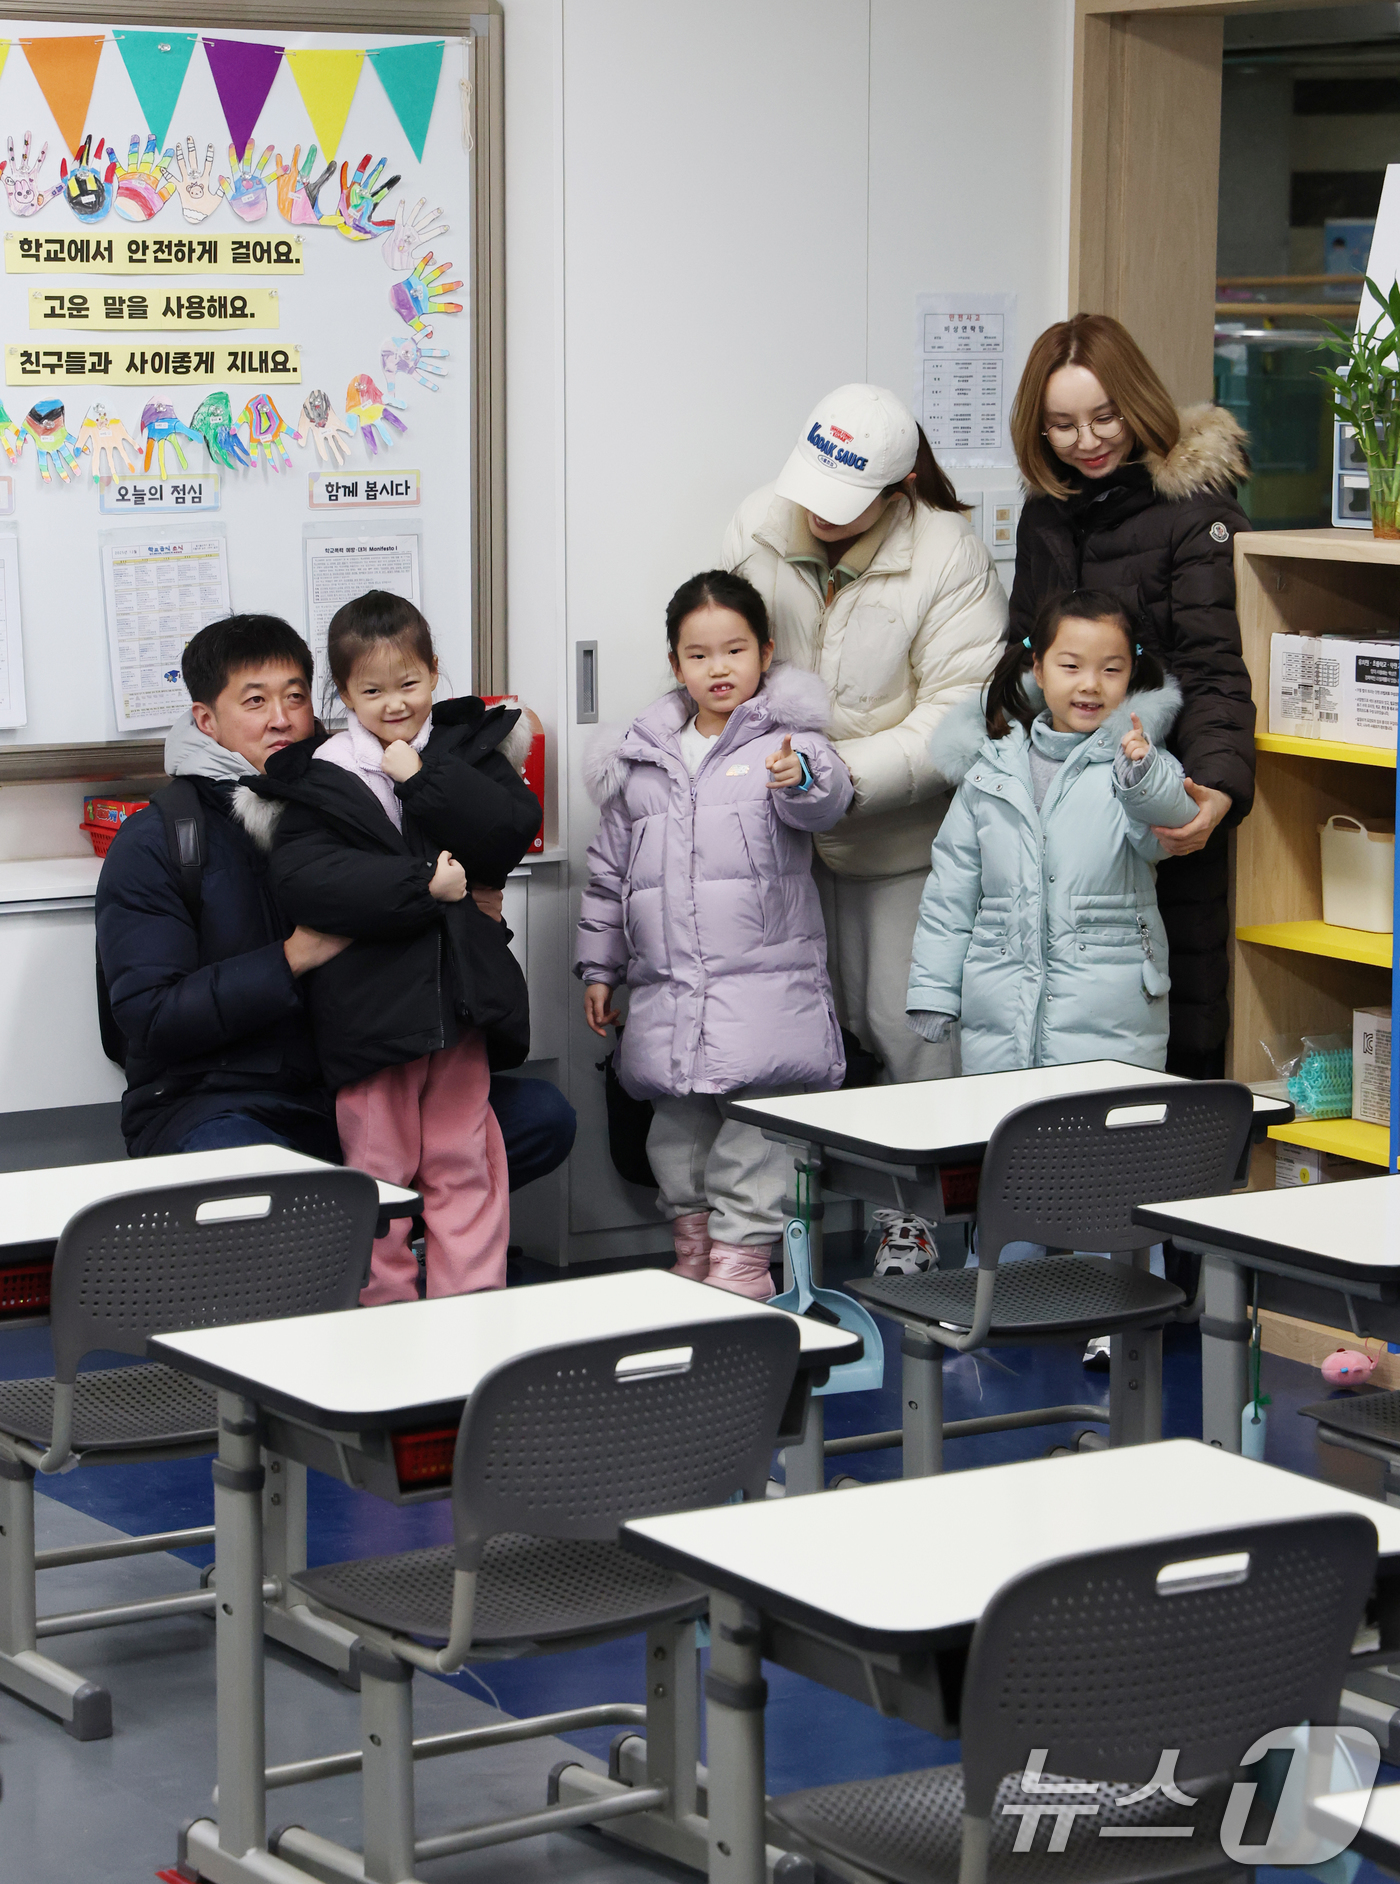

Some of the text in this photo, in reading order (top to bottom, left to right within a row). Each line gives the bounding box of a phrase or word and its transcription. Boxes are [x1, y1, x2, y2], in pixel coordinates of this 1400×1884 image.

[19, 238, 301, 264] 학교에서 안전하게 걸어요.
[43, 296, 256, 319] 고운 말을 사용해요.
[19, 351, 298, 375] 친구들과 사이좋게 지내요.
[807, 422, 837, 457] KODAK
[835, 448, 868, 471] SAUCE
[115, 483, 203, 505] 오늘의 점심
[325, 479, 411, 502] 함께 봅시다
